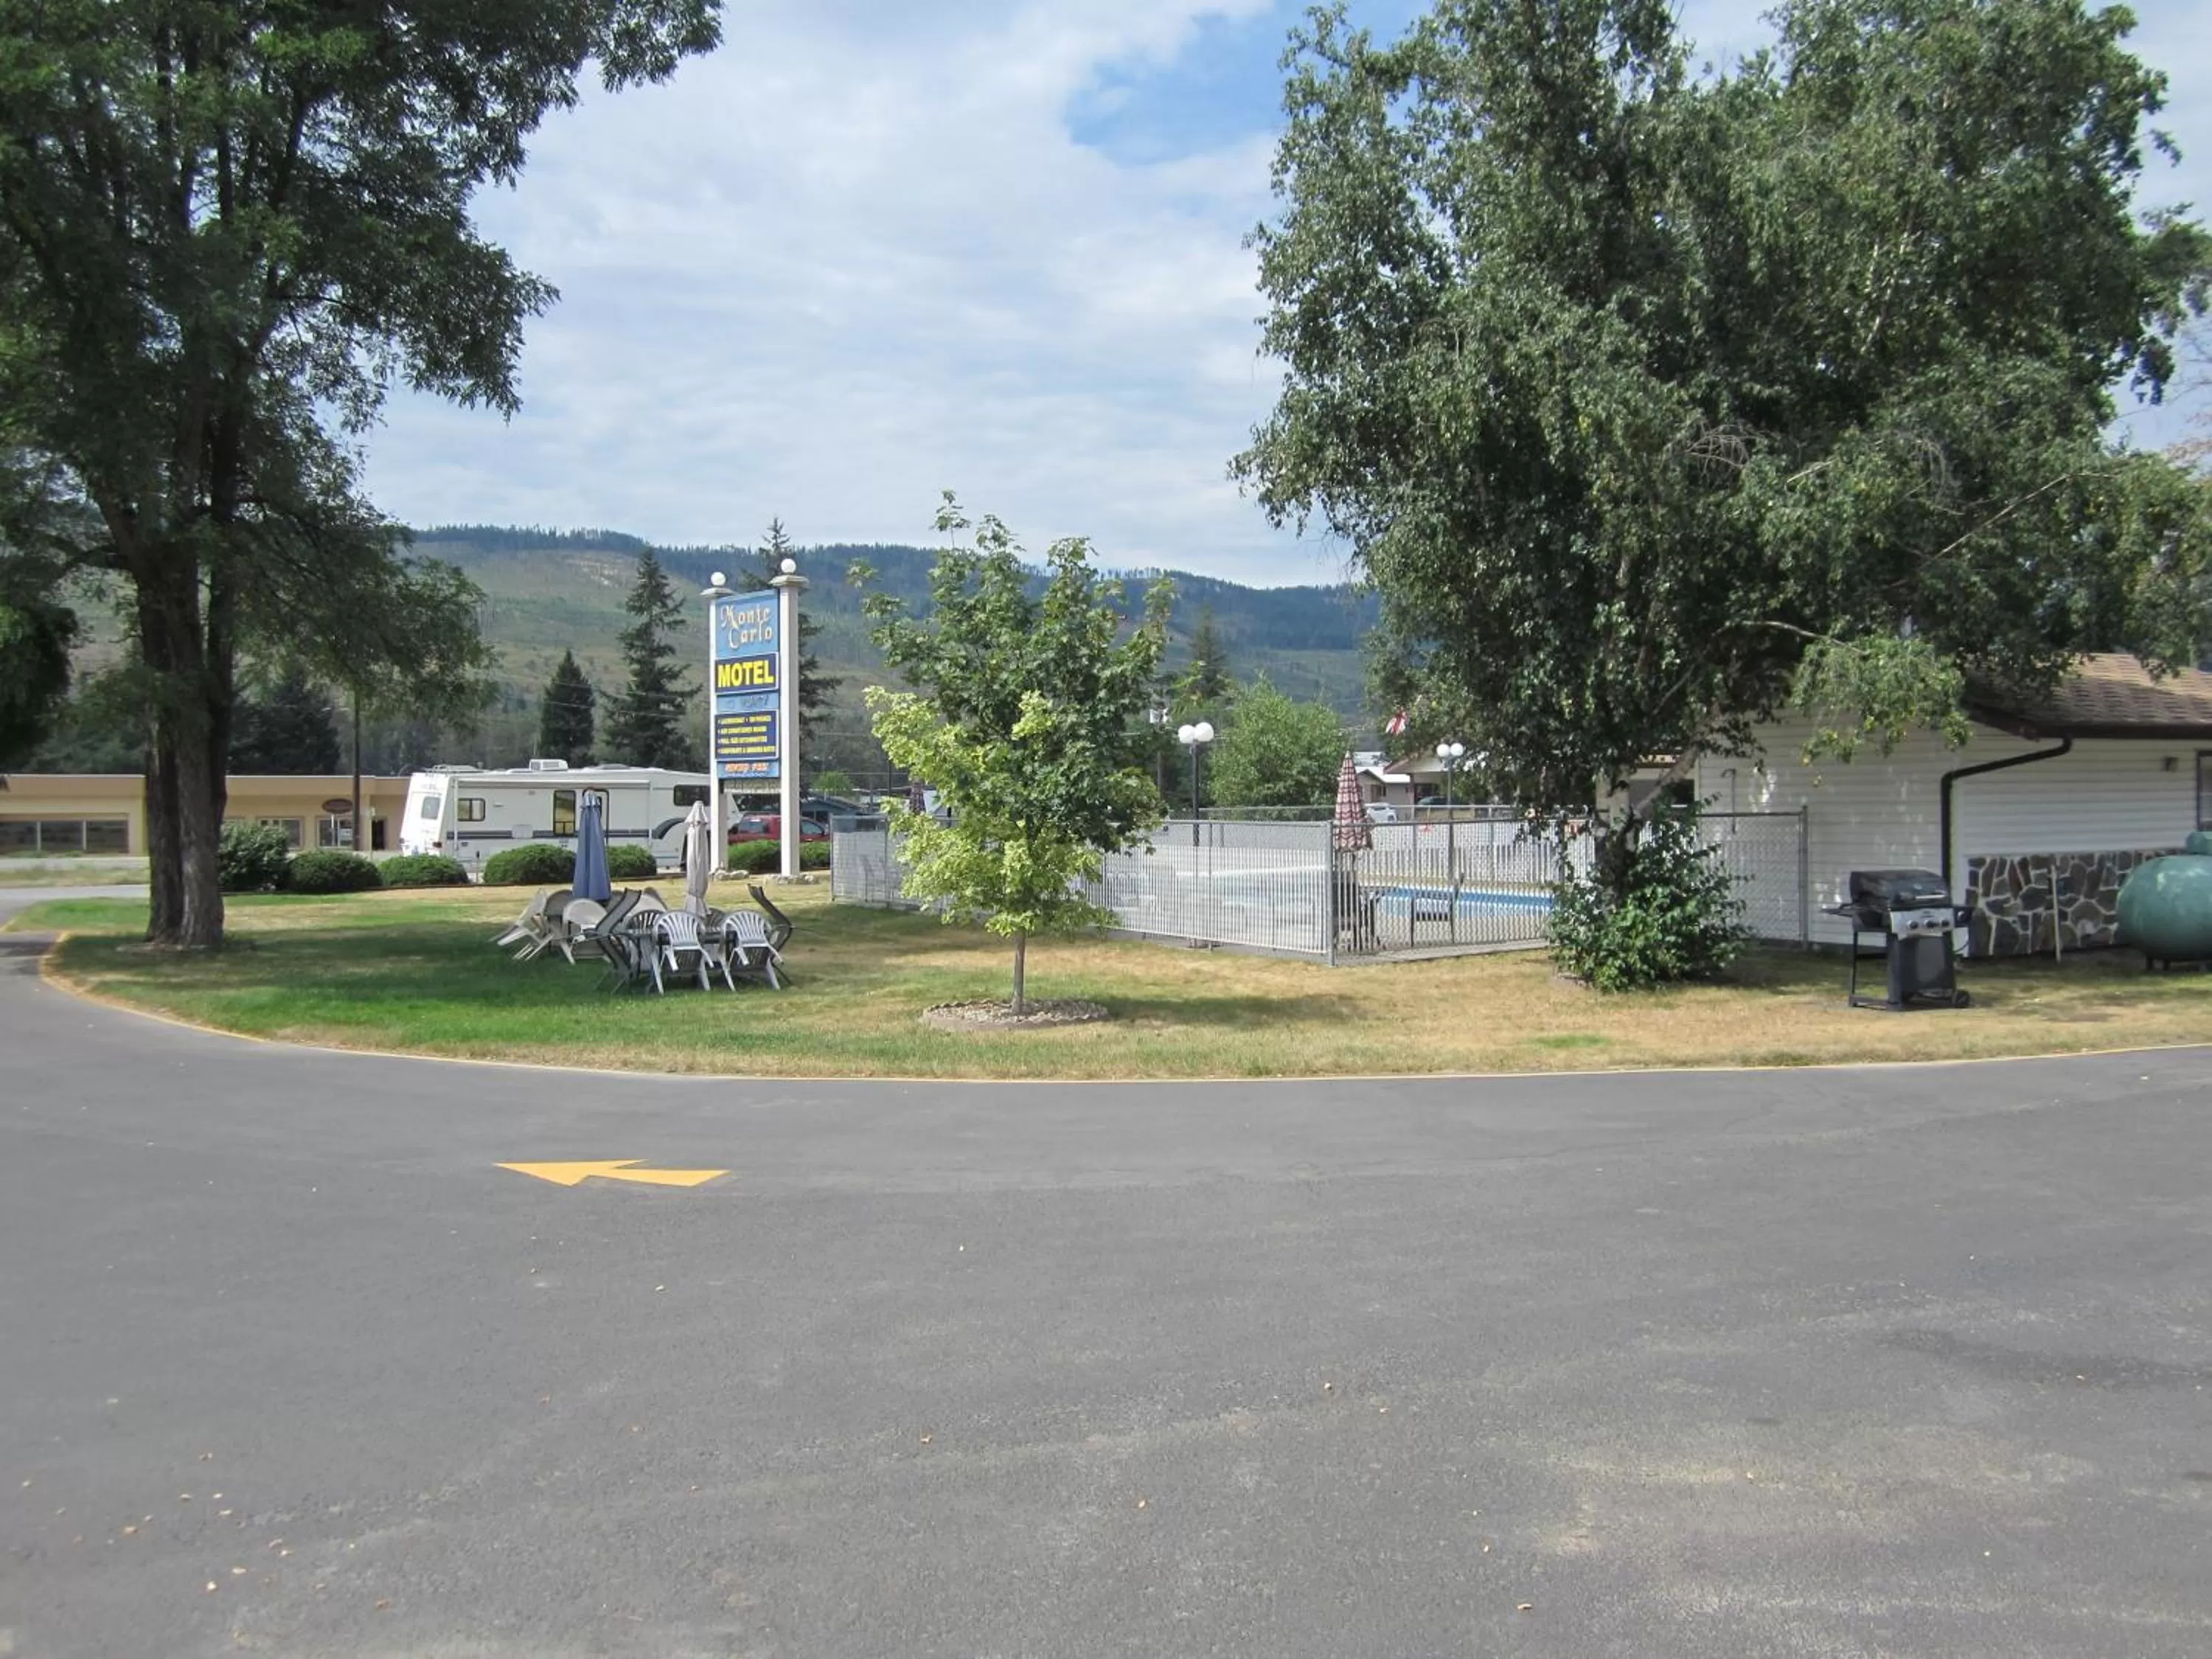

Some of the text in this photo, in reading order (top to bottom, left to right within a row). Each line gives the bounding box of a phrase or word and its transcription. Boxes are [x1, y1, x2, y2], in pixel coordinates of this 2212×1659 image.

[720, 603, 770, 627] Monte
[728, 619, 772, 648] Carlo
[717, 660, 774, 688] MOTEL
